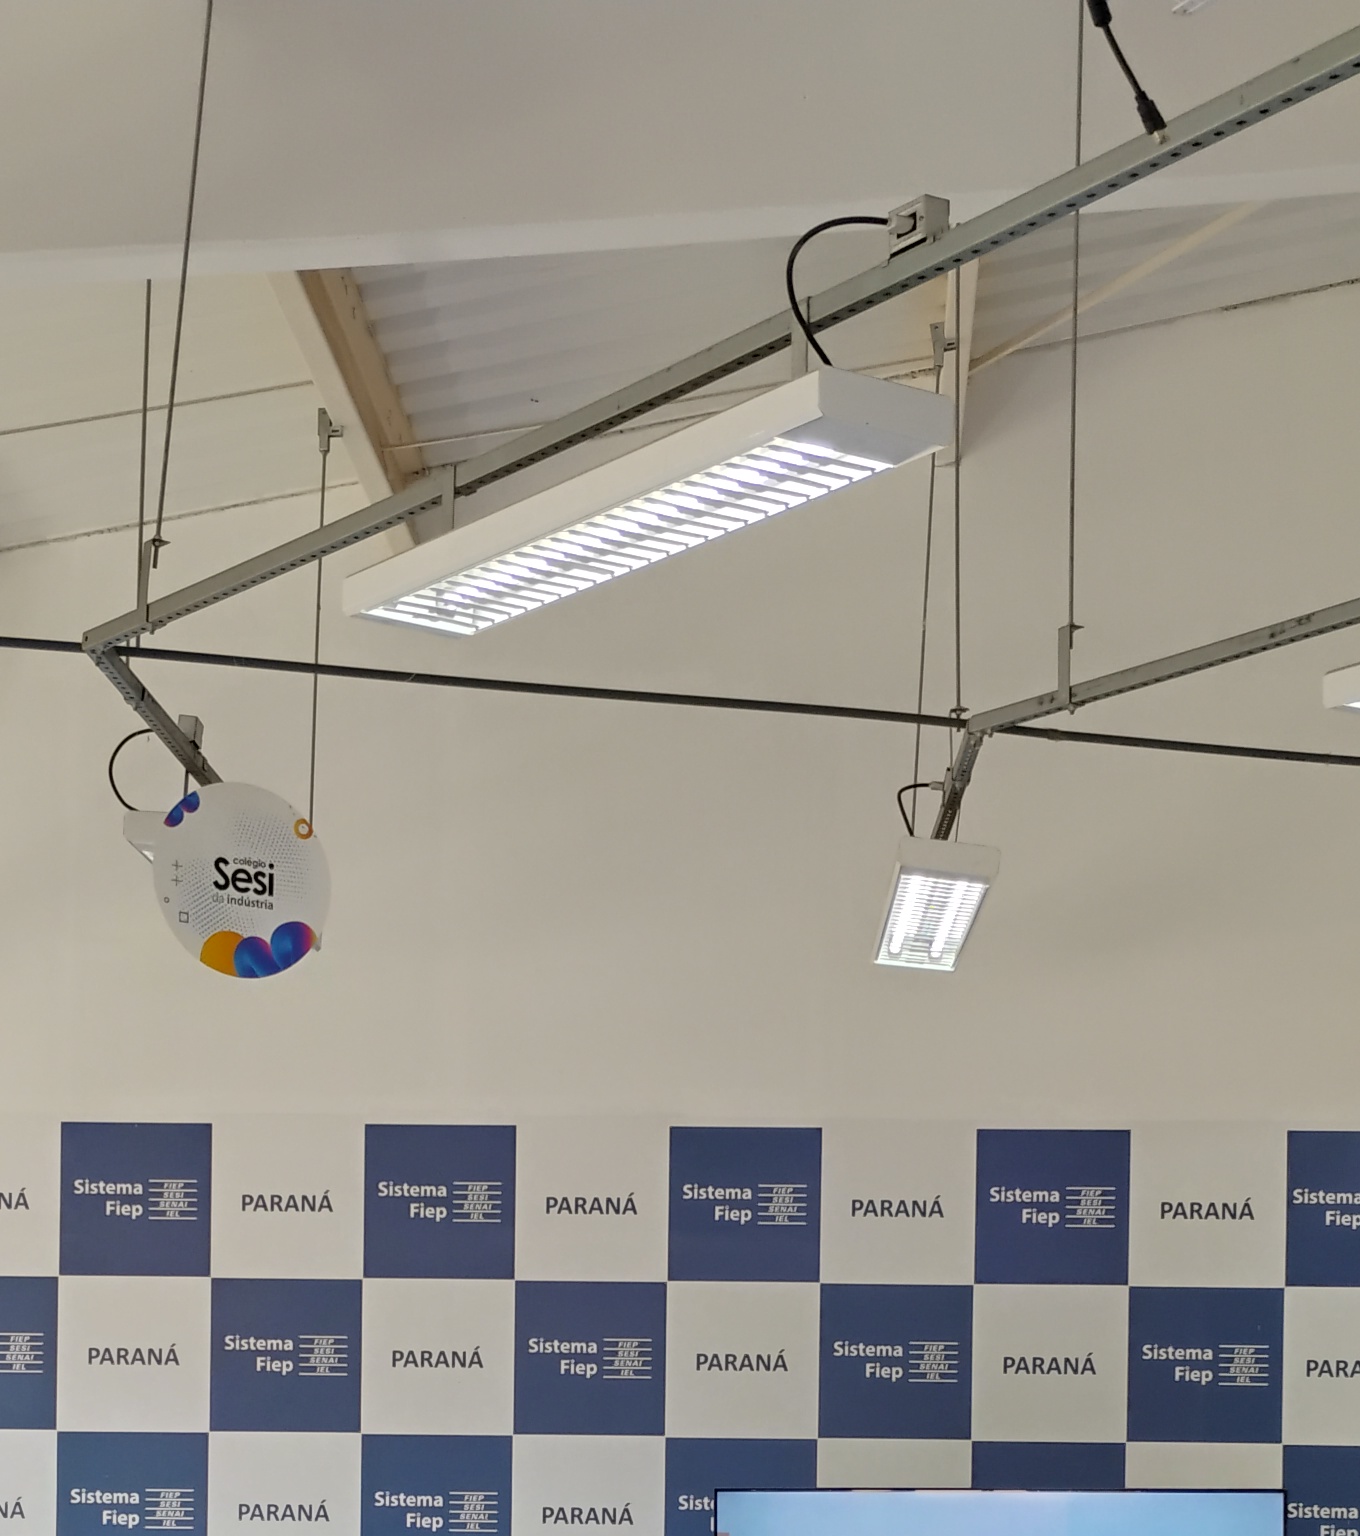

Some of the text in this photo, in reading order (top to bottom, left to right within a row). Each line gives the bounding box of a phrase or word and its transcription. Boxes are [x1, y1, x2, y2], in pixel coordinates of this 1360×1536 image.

[233, 857, 266, 869] colégio
[213, 857, 274, 896] Sesi
[227, 895, 274, 910] indústria
[74, 1179, 142, 1194] Sistema
[378, 1182, 446, 1197] Sistema
[683, 1184, 751, 1199] Sistema
[990, 1187, 1059, 1202] Sistema
[106, 1201, 143, 1219] Fiep
[242, 1190, 333, 1212] PARANÁ
[546, 1192, 637, 1215] PARANÁ
[852, 1195, 944, 1218] PARANÁ
[1161, 1198, 1254, 1220] PARANÁ
[410, 1203, 447, 1222] Fiep
[715, 1206, 751, 1224] Fiep
[1022, 1209, 1059, 1227] Fiep
[225, 1335, 293, 1350] Sistema
[529, 1338, 597, 1353] Sistema
[834, 1341, 902, 1356] Sistema
[88, 1344, 179, 1365] PARANÁ
[392, 1346, 483, 1368] PARANÁ
[697, 1349, 788, 1371] PARANÁ
[1142, 1344, 1213, 1360] Sistema
[257, 1357, 293, 1375] Fiep
[561, 1359, 597, 1378] Fiep
[866, 1363, 903, 1382] Fiep
[1004, 1353, 1096, 1375] PARANÁ
[1175, 1366, 1213, 1385] Fiep
[71, 1489, 139, 1504] Sistema
[375, 1491, 443, 1506] Sistema
[103, 1510, 139, 1528] Fiep
[239, 1500, 329, 1521] PARANÁ
[543, 1503, 633, 1525] PARANÁ
[1288, 1503, 1358, 1519] Sistema
[407, 1513, 443, 1531] Fiep
